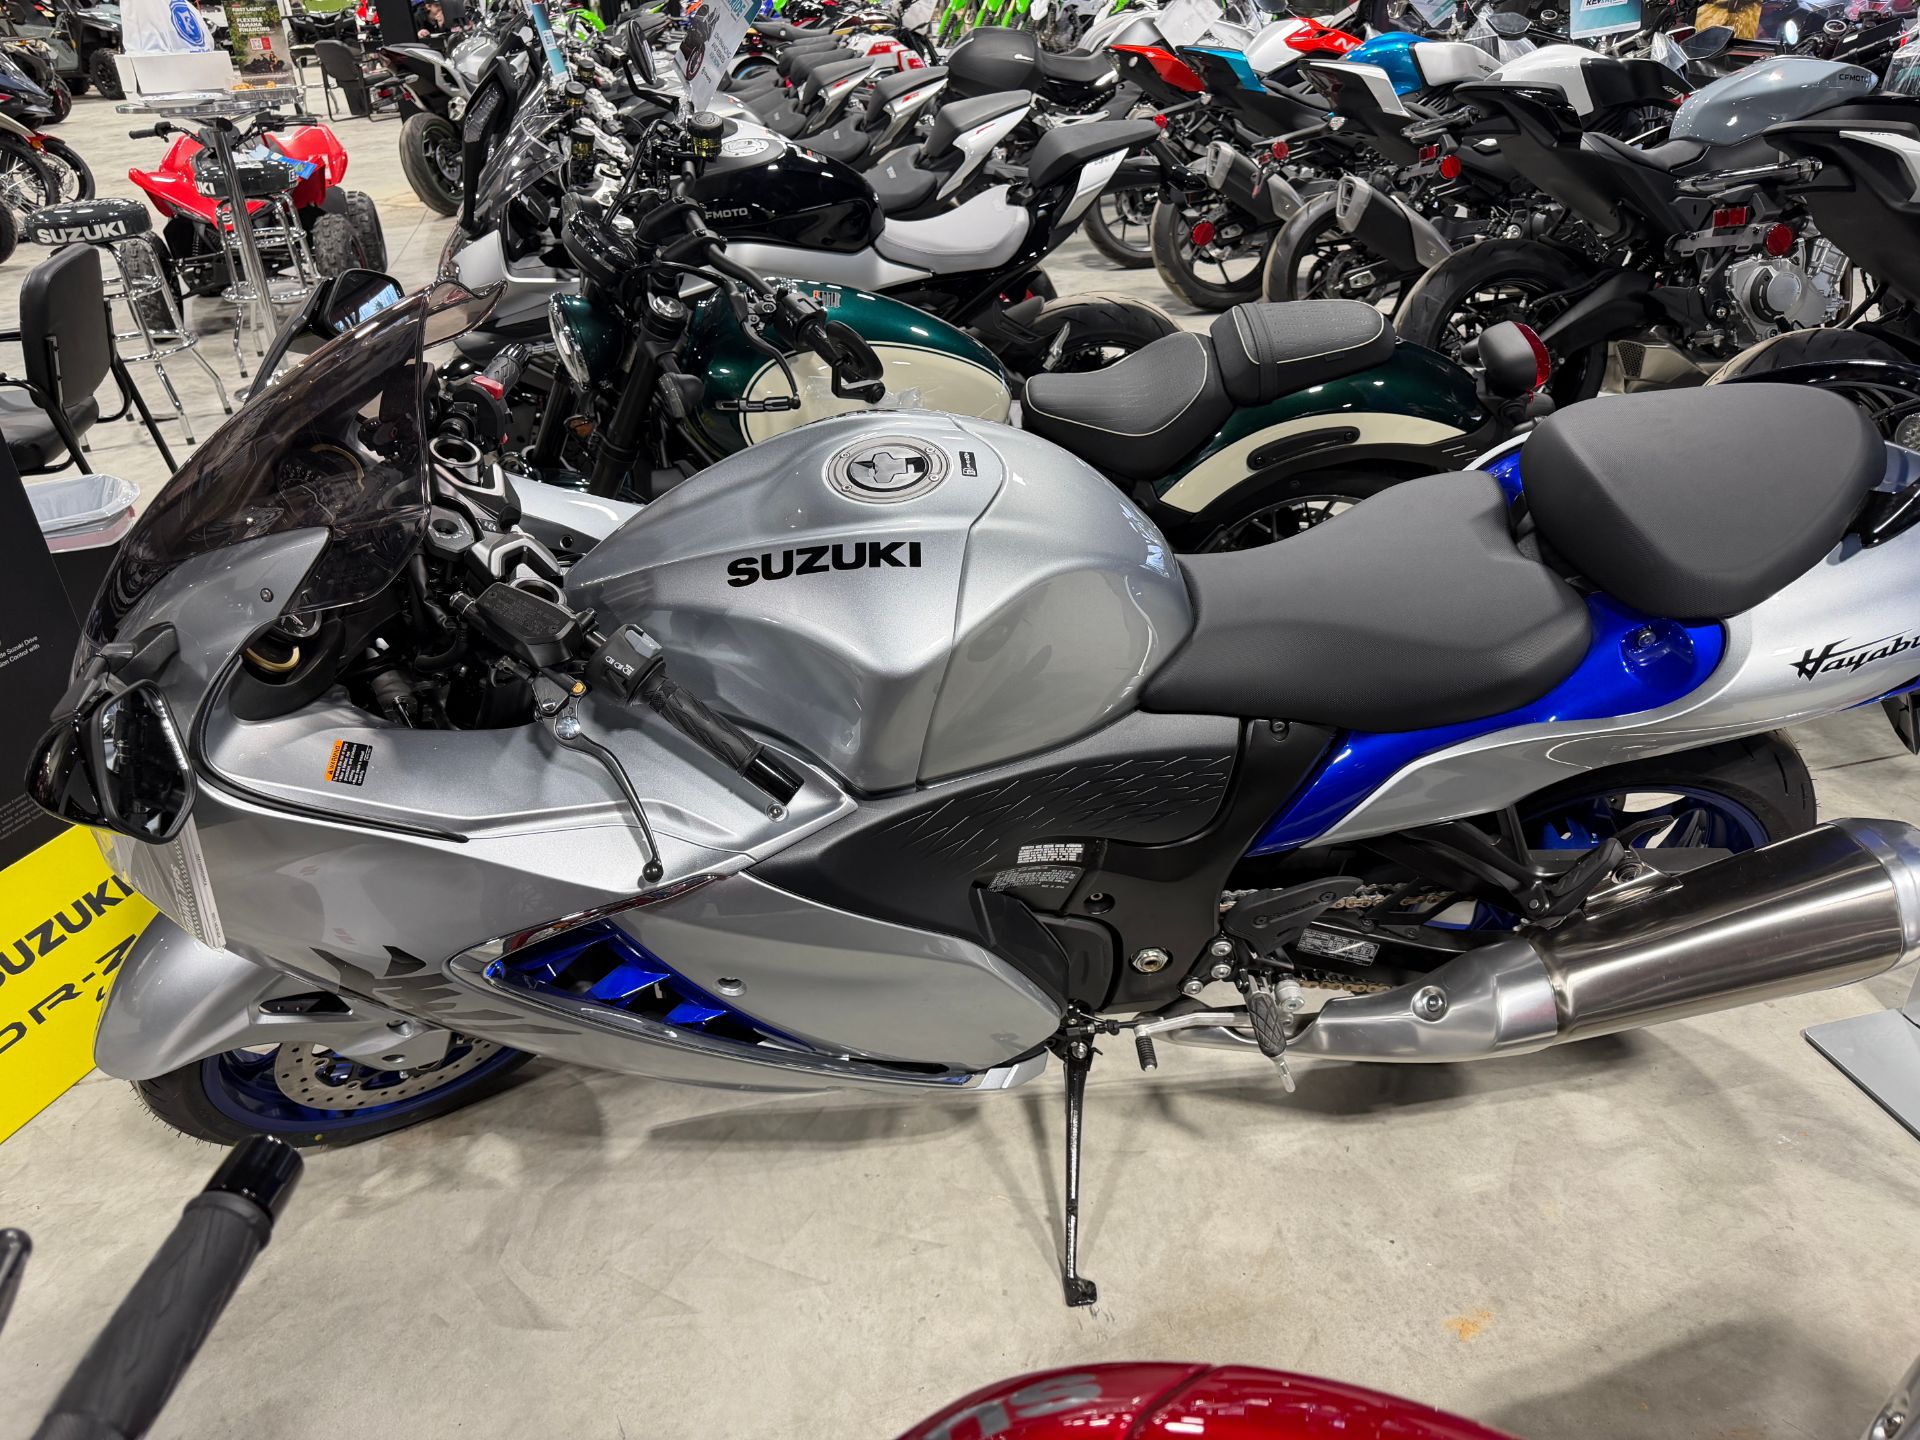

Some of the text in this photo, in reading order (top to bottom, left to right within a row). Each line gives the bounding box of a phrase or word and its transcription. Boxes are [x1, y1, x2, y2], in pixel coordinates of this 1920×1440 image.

[704, 206, 749, 220] FMOTO
[37, 220, 127, 244] SUZUKI
[727, 541, 922, 588] SUZUKI
[9, 649, 28, 662] Control
[0, 874, 135, 988] UZUKI
